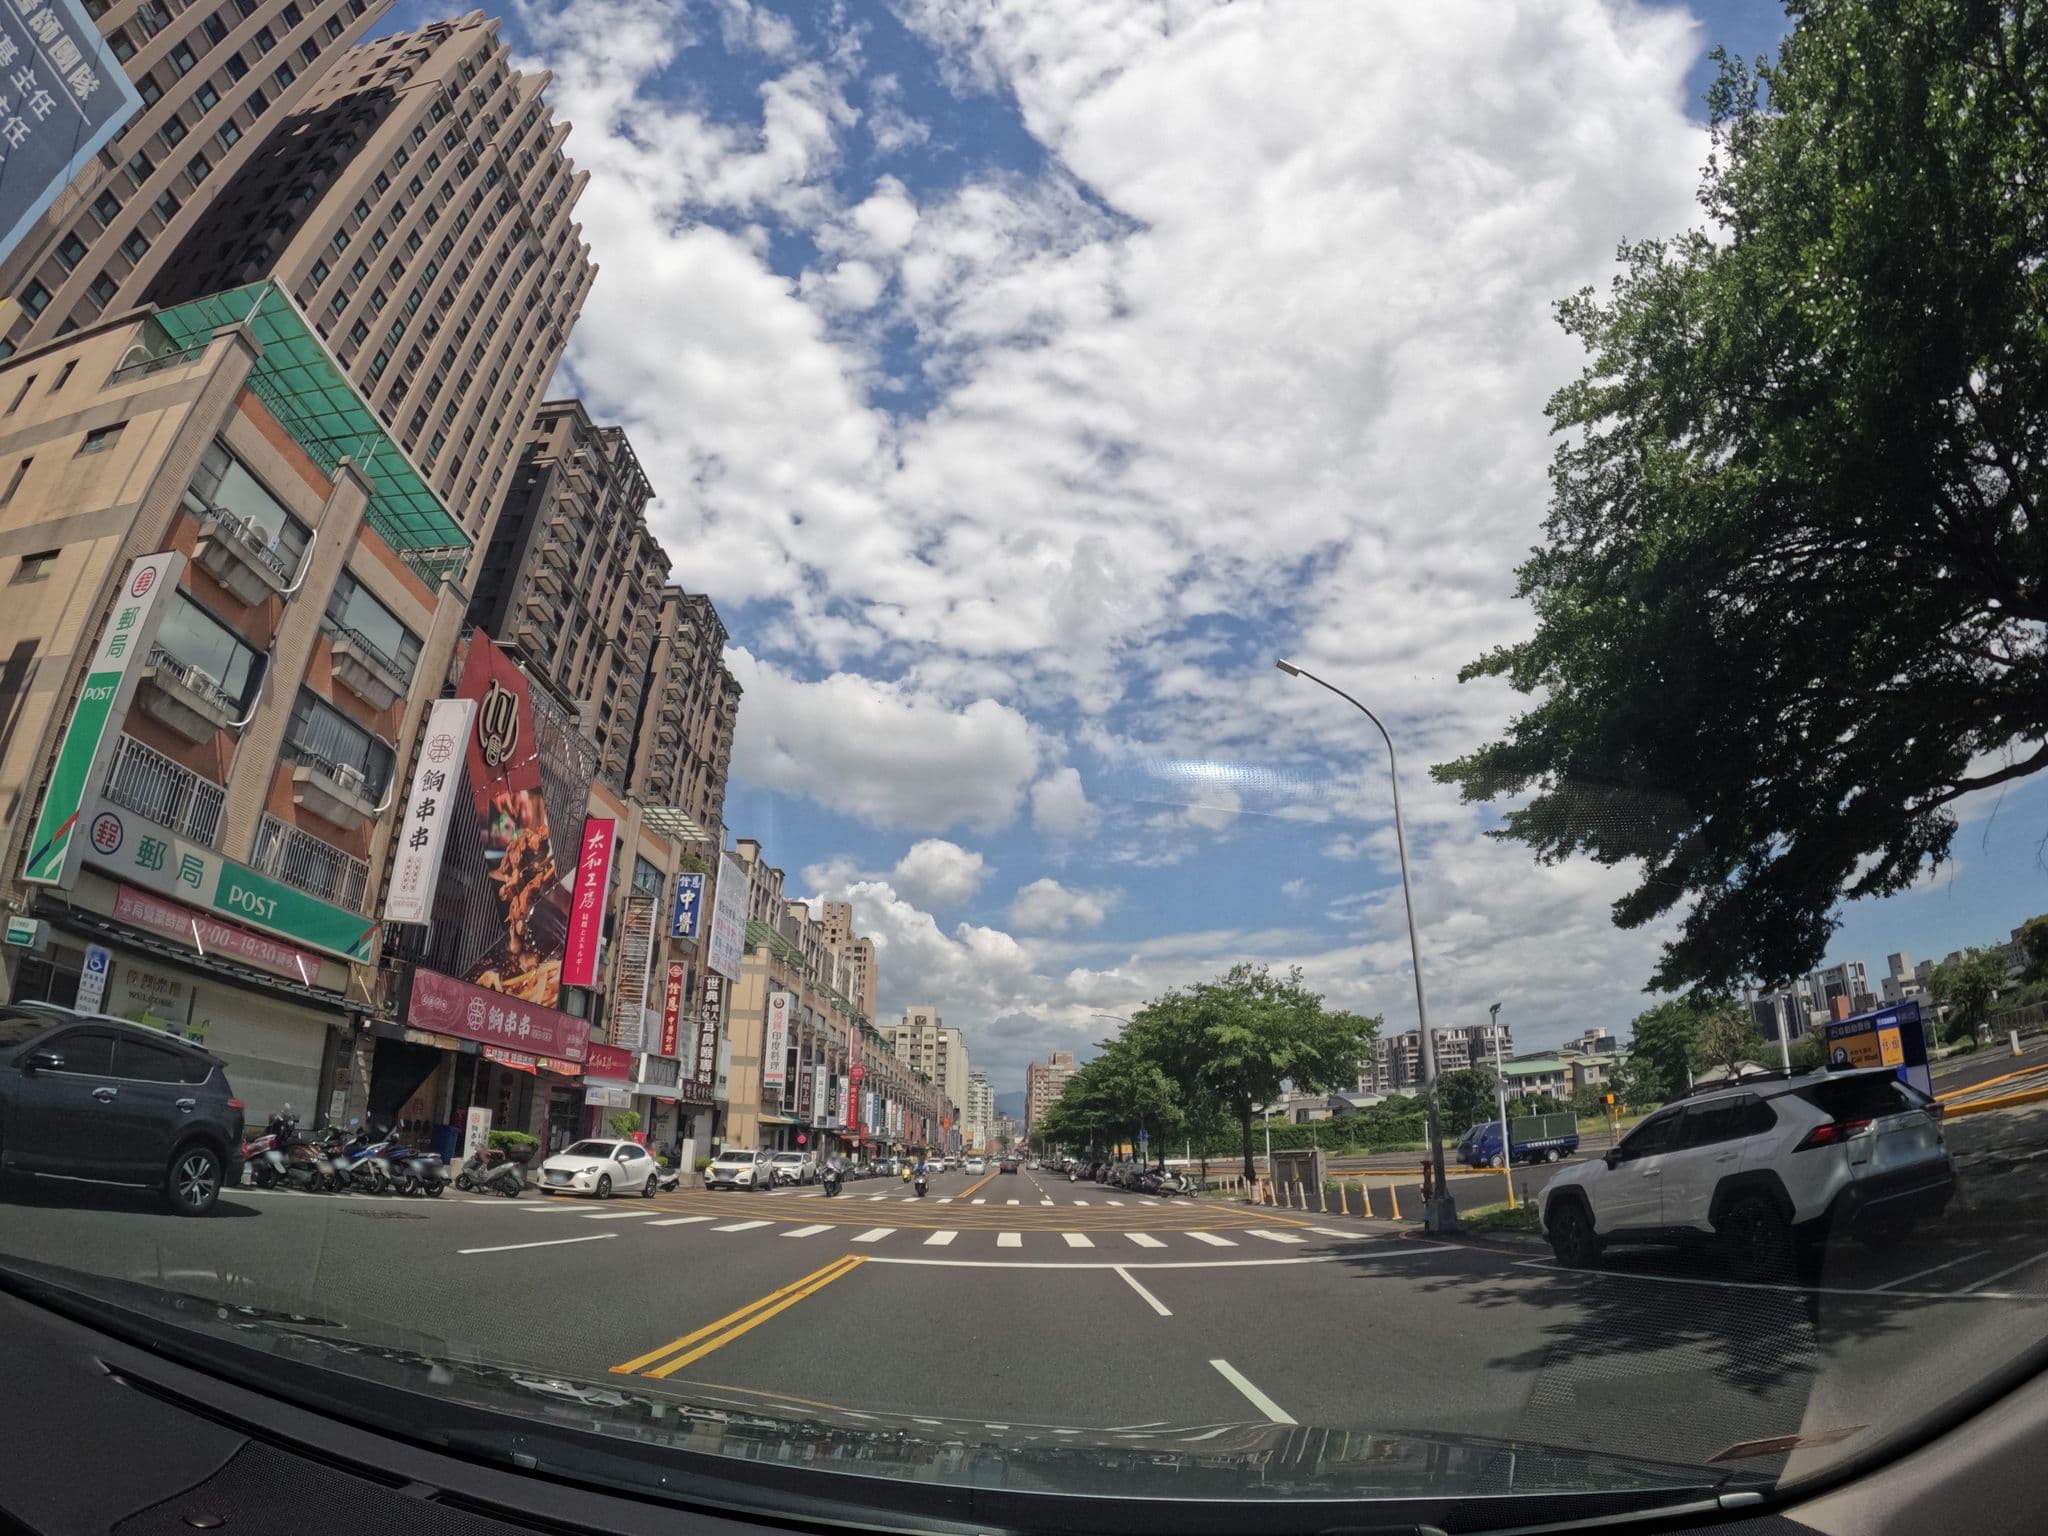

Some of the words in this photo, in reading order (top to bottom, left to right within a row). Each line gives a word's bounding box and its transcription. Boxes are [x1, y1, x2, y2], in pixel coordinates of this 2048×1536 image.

[105, 606, 141, 659] 郵局
[83, 686, 115, 702] POST
[408, 769, 446, 852] 餉串串
[134, 834, 205, 889] 郵局
[579, 829, 605, 910] 太和工房
[228, 884, 278, 920] POST
[676, 889, 697, 934] 中醫
[704, 977, 720, 1003] 世典
[698, 1020, 716, 1085] 耳鼻喉專科
